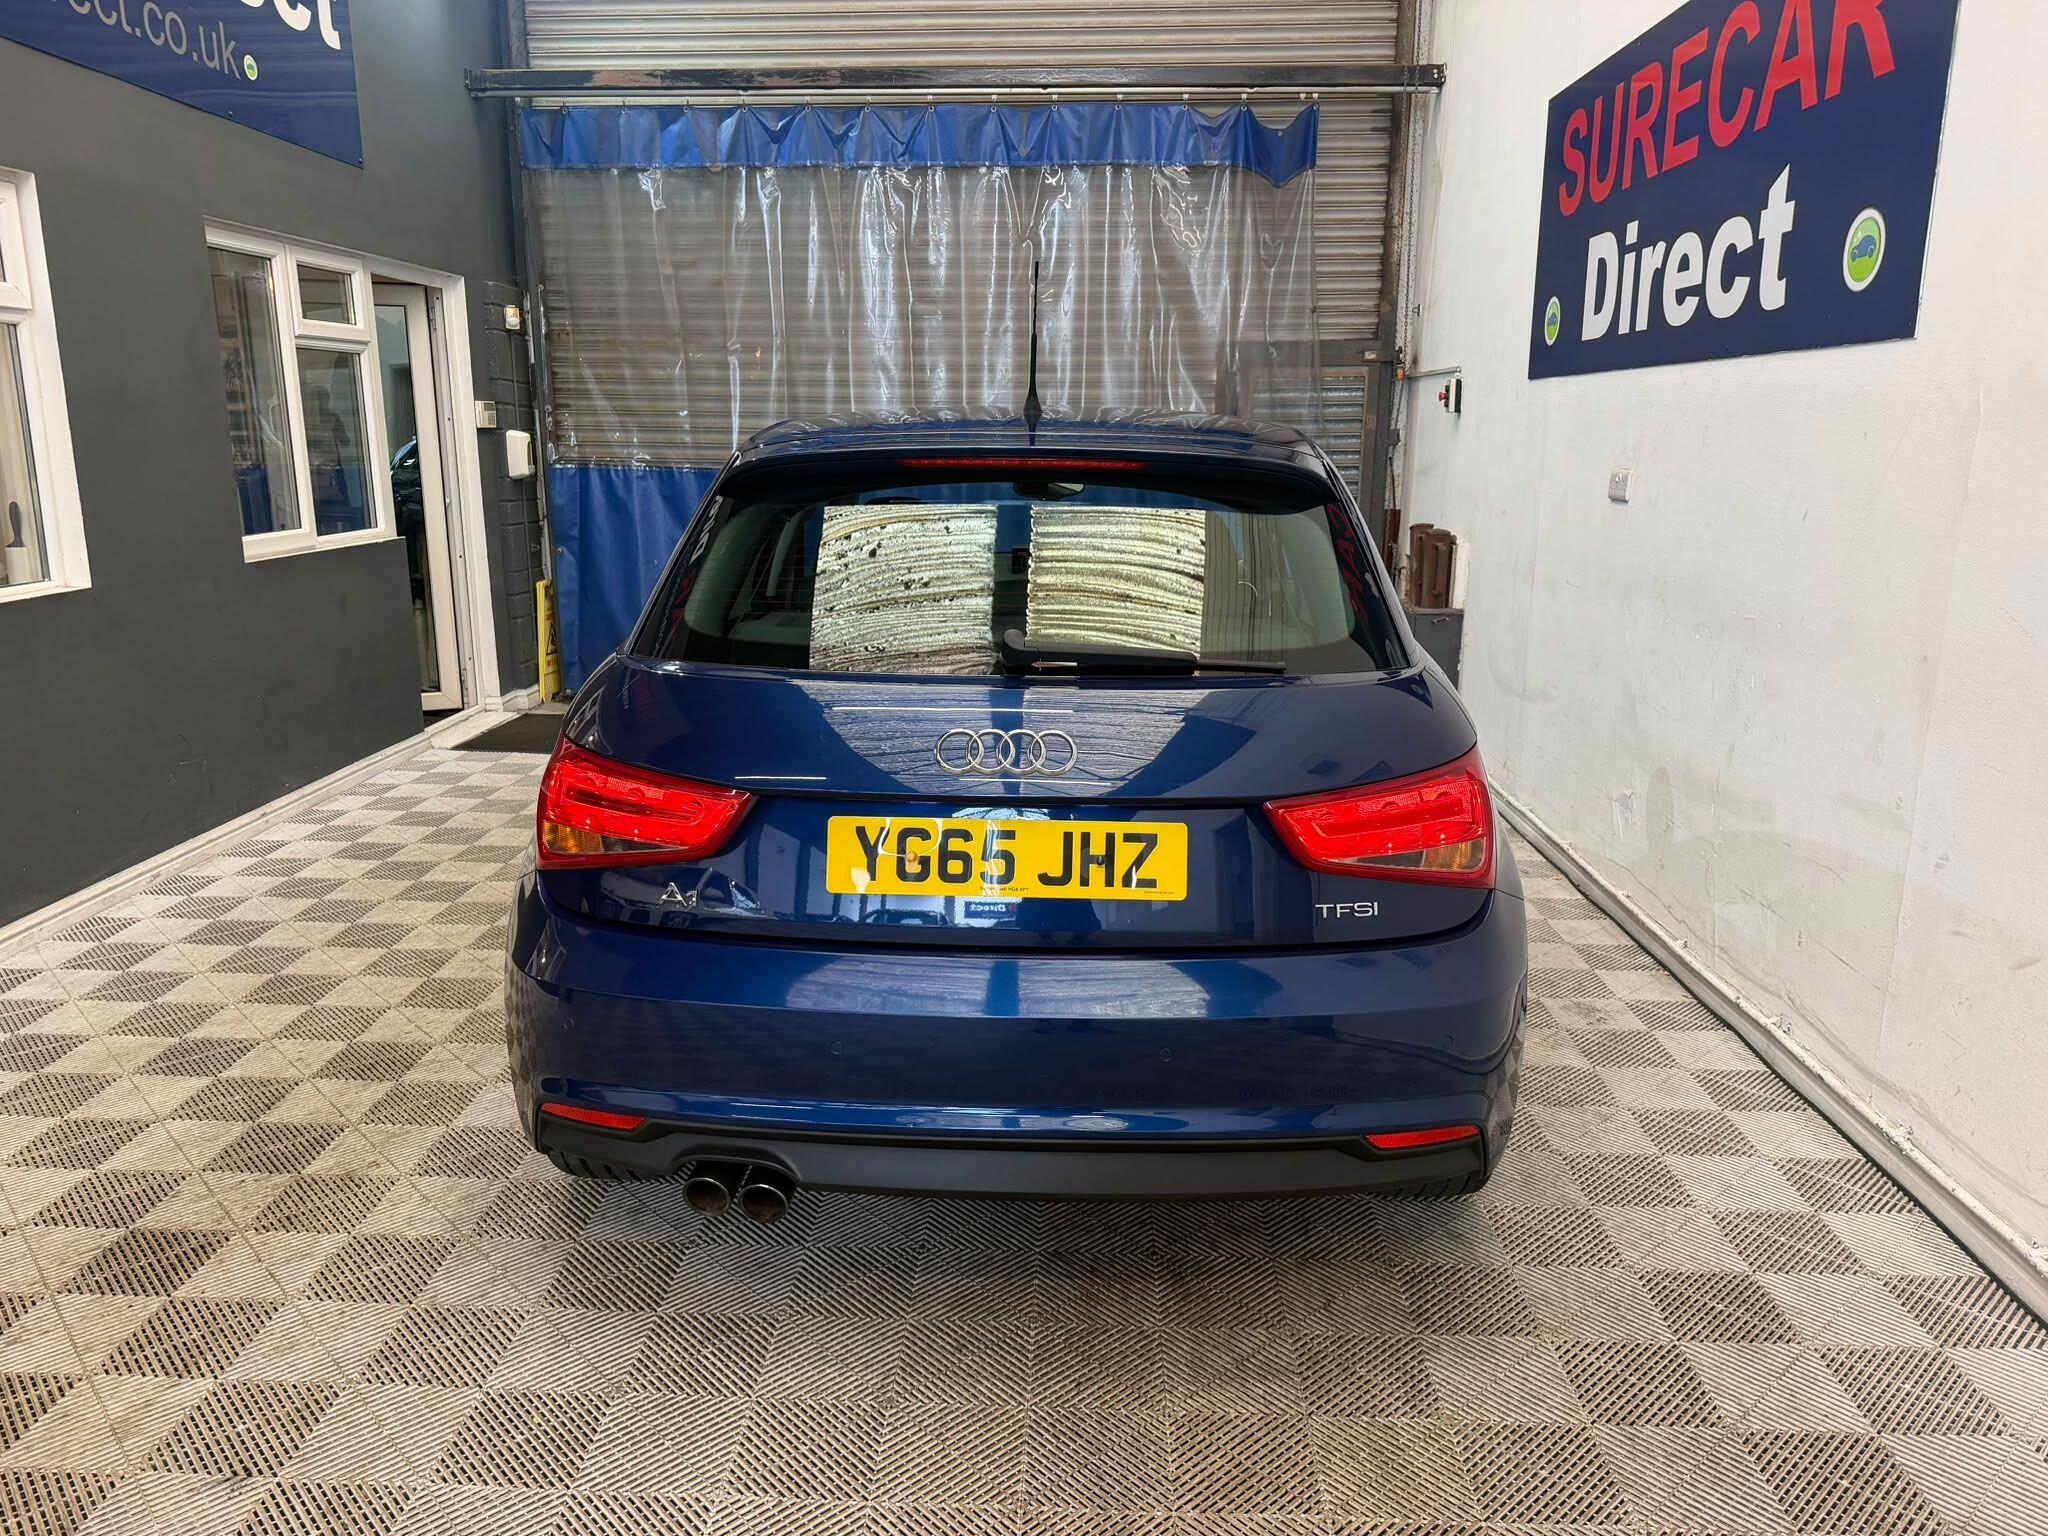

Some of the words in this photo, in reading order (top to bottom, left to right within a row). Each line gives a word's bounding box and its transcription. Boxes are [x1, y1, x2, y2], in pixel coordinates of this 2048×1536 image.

[1558, 0, 1896, 216] SURECAR
[1581, 164, 1795, 341] Direct
[855, 825, 1016, 885] YG65
[1037, 831, 1158, 889] JHZ
[1314, 901, 1378, 919] TFSI
